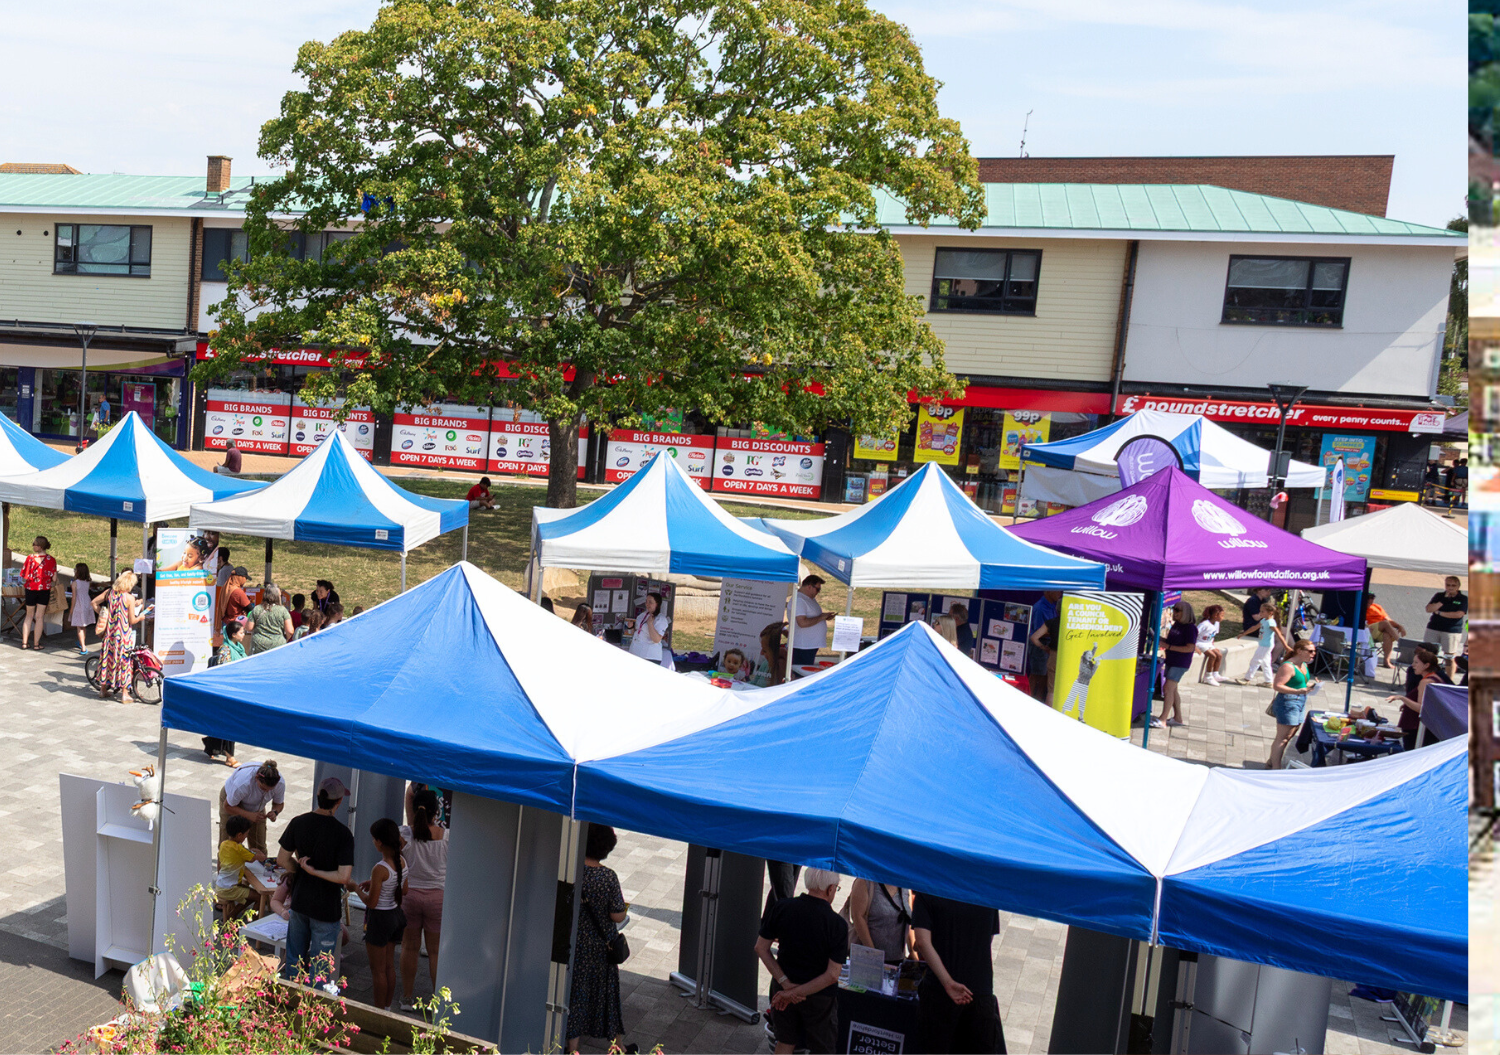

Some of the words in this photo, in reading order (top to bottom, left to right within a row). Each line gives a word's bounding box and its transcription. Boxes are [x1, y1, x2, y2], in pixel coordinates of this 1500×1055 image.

[240, 405, 272, 413] BRANDS
[303, 409, 318, 417] BIG
[929, 406, 953, 418] 99p
[1144, 401, 1305, 420] poundstretcher
[1312, 414, 1338, 423] every
[1340, 416, 1368, 425] penny
[1014, 411, 1040, 423] 99p
[414, 417, 430, 425] BIG
[432, 418, 467, 428] BRANDS
[505, 424, 521, 432] BIG
[633, 433, 650, 442] BIG
[652, 435, 691, 445] BRANDS
[237, 441, 254, 449] DAYS
[732, 440, 749, 449] BIG
[752, 442, 811, 453] DISCOUNTS
[400, 454, 420, 462] OPEN
[428, 456, 447, 464] DAYS
[498, 462, 518, 470] OPEN
[724, 481, 747, 489] OPEN
[1071, 526, 1118, 539] willow
[1218, 538, 1268, 548] willow
[1203, 569, 1330, 581] www.willowfoundation.org.uk
[1067, 623, 1123, 631] LEASEHOLDER?
[1066, 630, 1084, 640] Get
